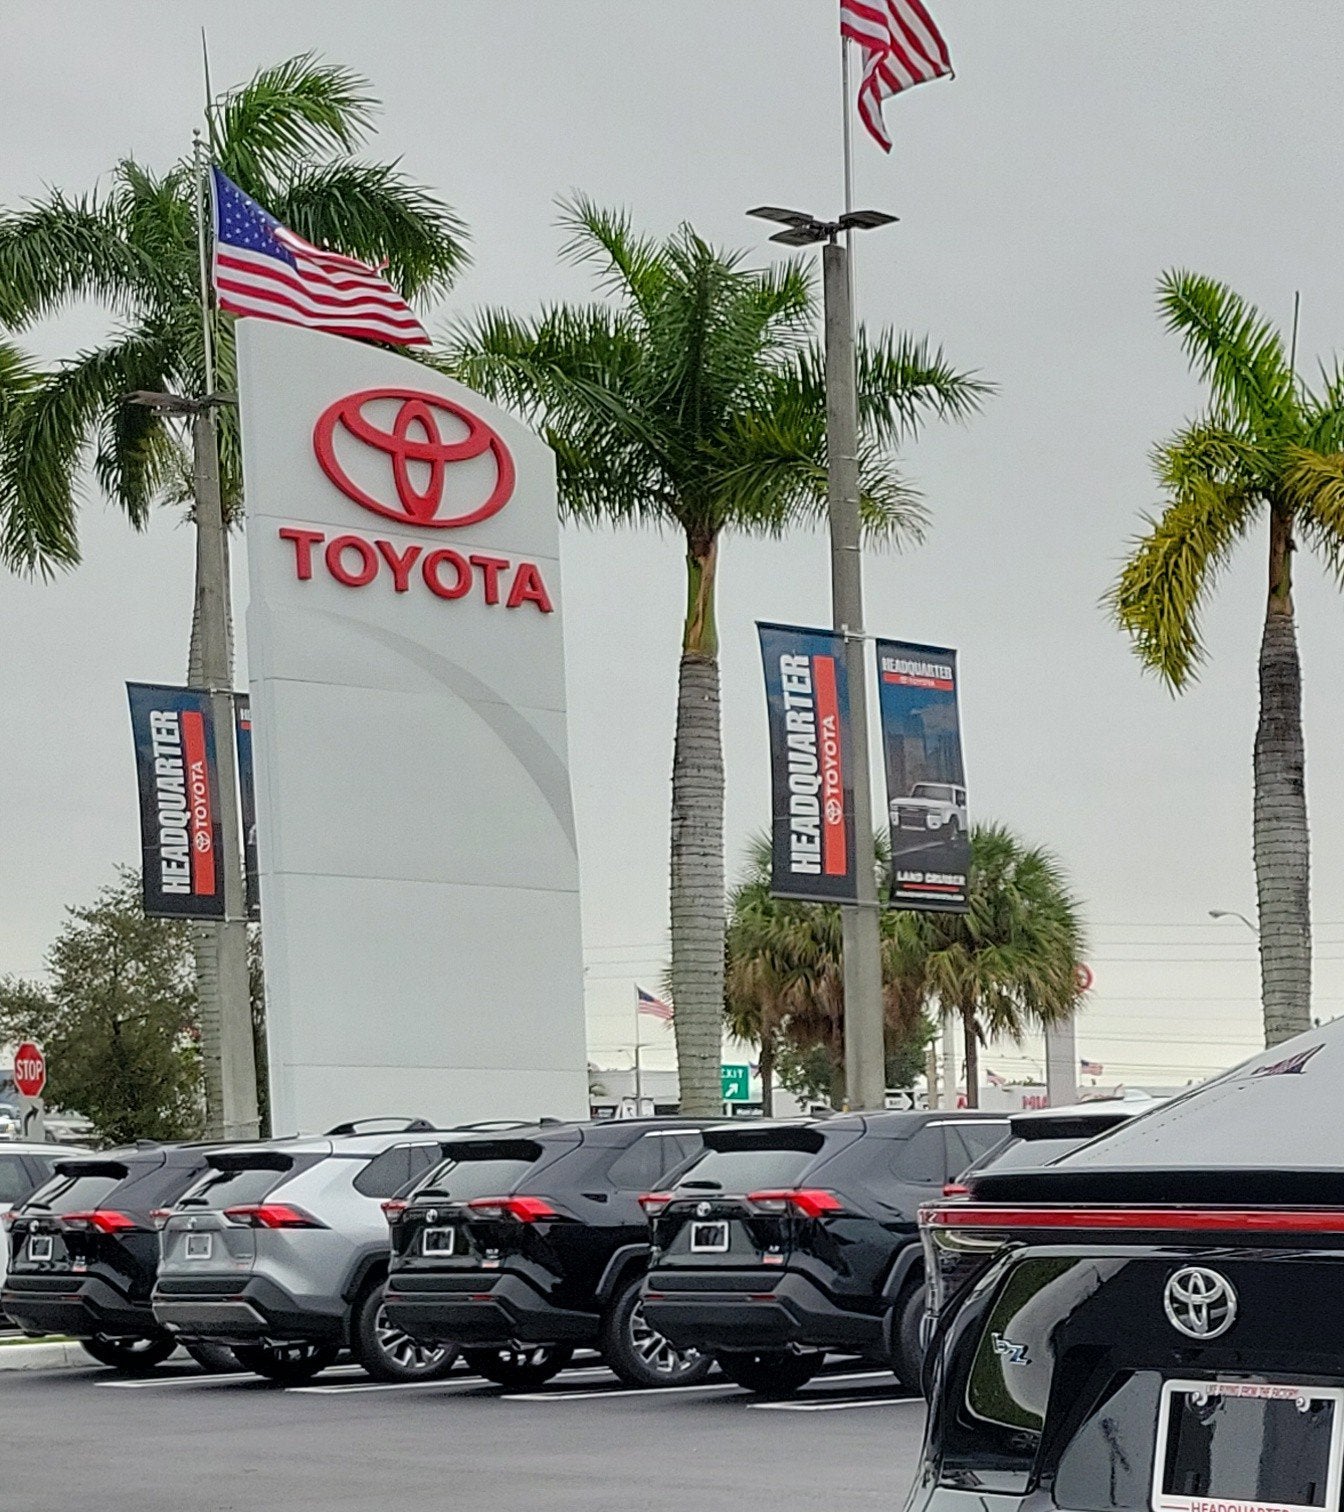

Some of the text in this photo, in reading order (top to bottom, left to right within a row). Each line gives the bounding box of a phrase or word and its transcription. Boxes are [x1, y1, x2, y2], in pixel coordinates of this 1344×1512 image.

[279, 527, 554, 613] TOYOTA
[882, 656, 953, 680] HEADQUARTER
[780, 653, 822, 875] HEADQUARTER
[822, 714, 840, 795] TOYOTA
[150, 709, 192, 895] HEADQUARTER
[191, 760, 209, 828] TOYOTA
[896, 870, 923, 882] LAND
[16, 1060, 43, 1080] STOP
